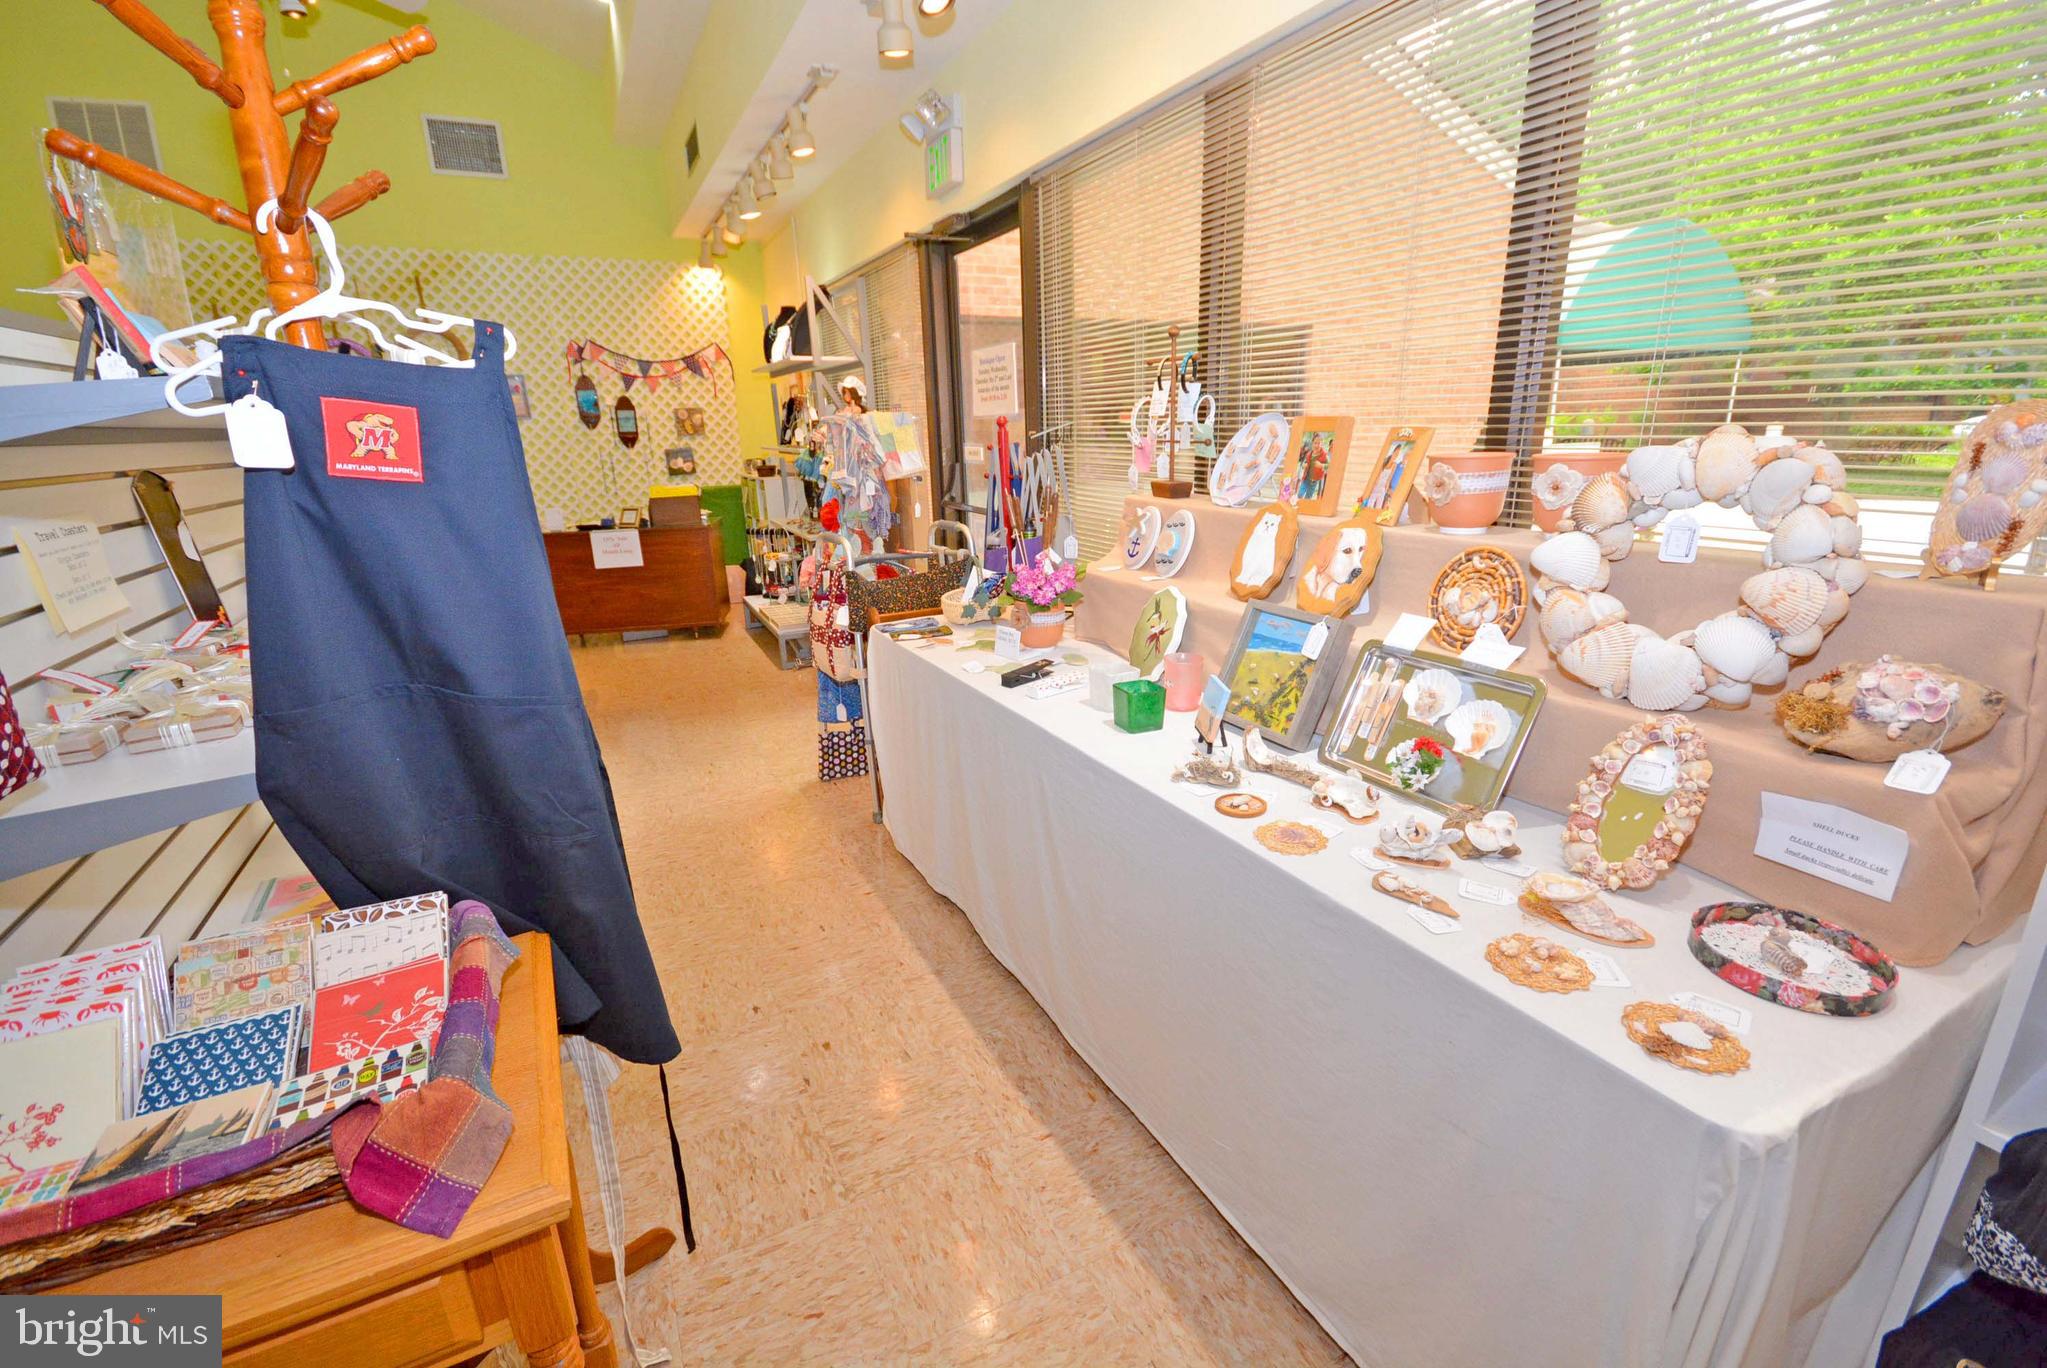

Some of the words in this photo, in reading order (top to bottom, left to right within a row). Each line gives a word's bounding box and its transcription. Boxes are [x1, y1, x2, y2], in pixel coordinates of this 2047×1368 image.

[927, 133, 949, 192] EXIT
[362, 426, 393, 449] M
[335, 462, 377, 472] MARYLAND
[378, 465, 413, 474] TERRAPINS
[34, 529, 60, 543] Travel
[60, 524, 88, 537] Coasters
[1812, 821, 1835, 834] SHELL
[1788, 834, 1814, 849] PLEASE
[1817, 843, 1846, 860] HANDLE
[1848, 856, 1868, 868] WITH
[1869, 863, 1890, 876] CARE
